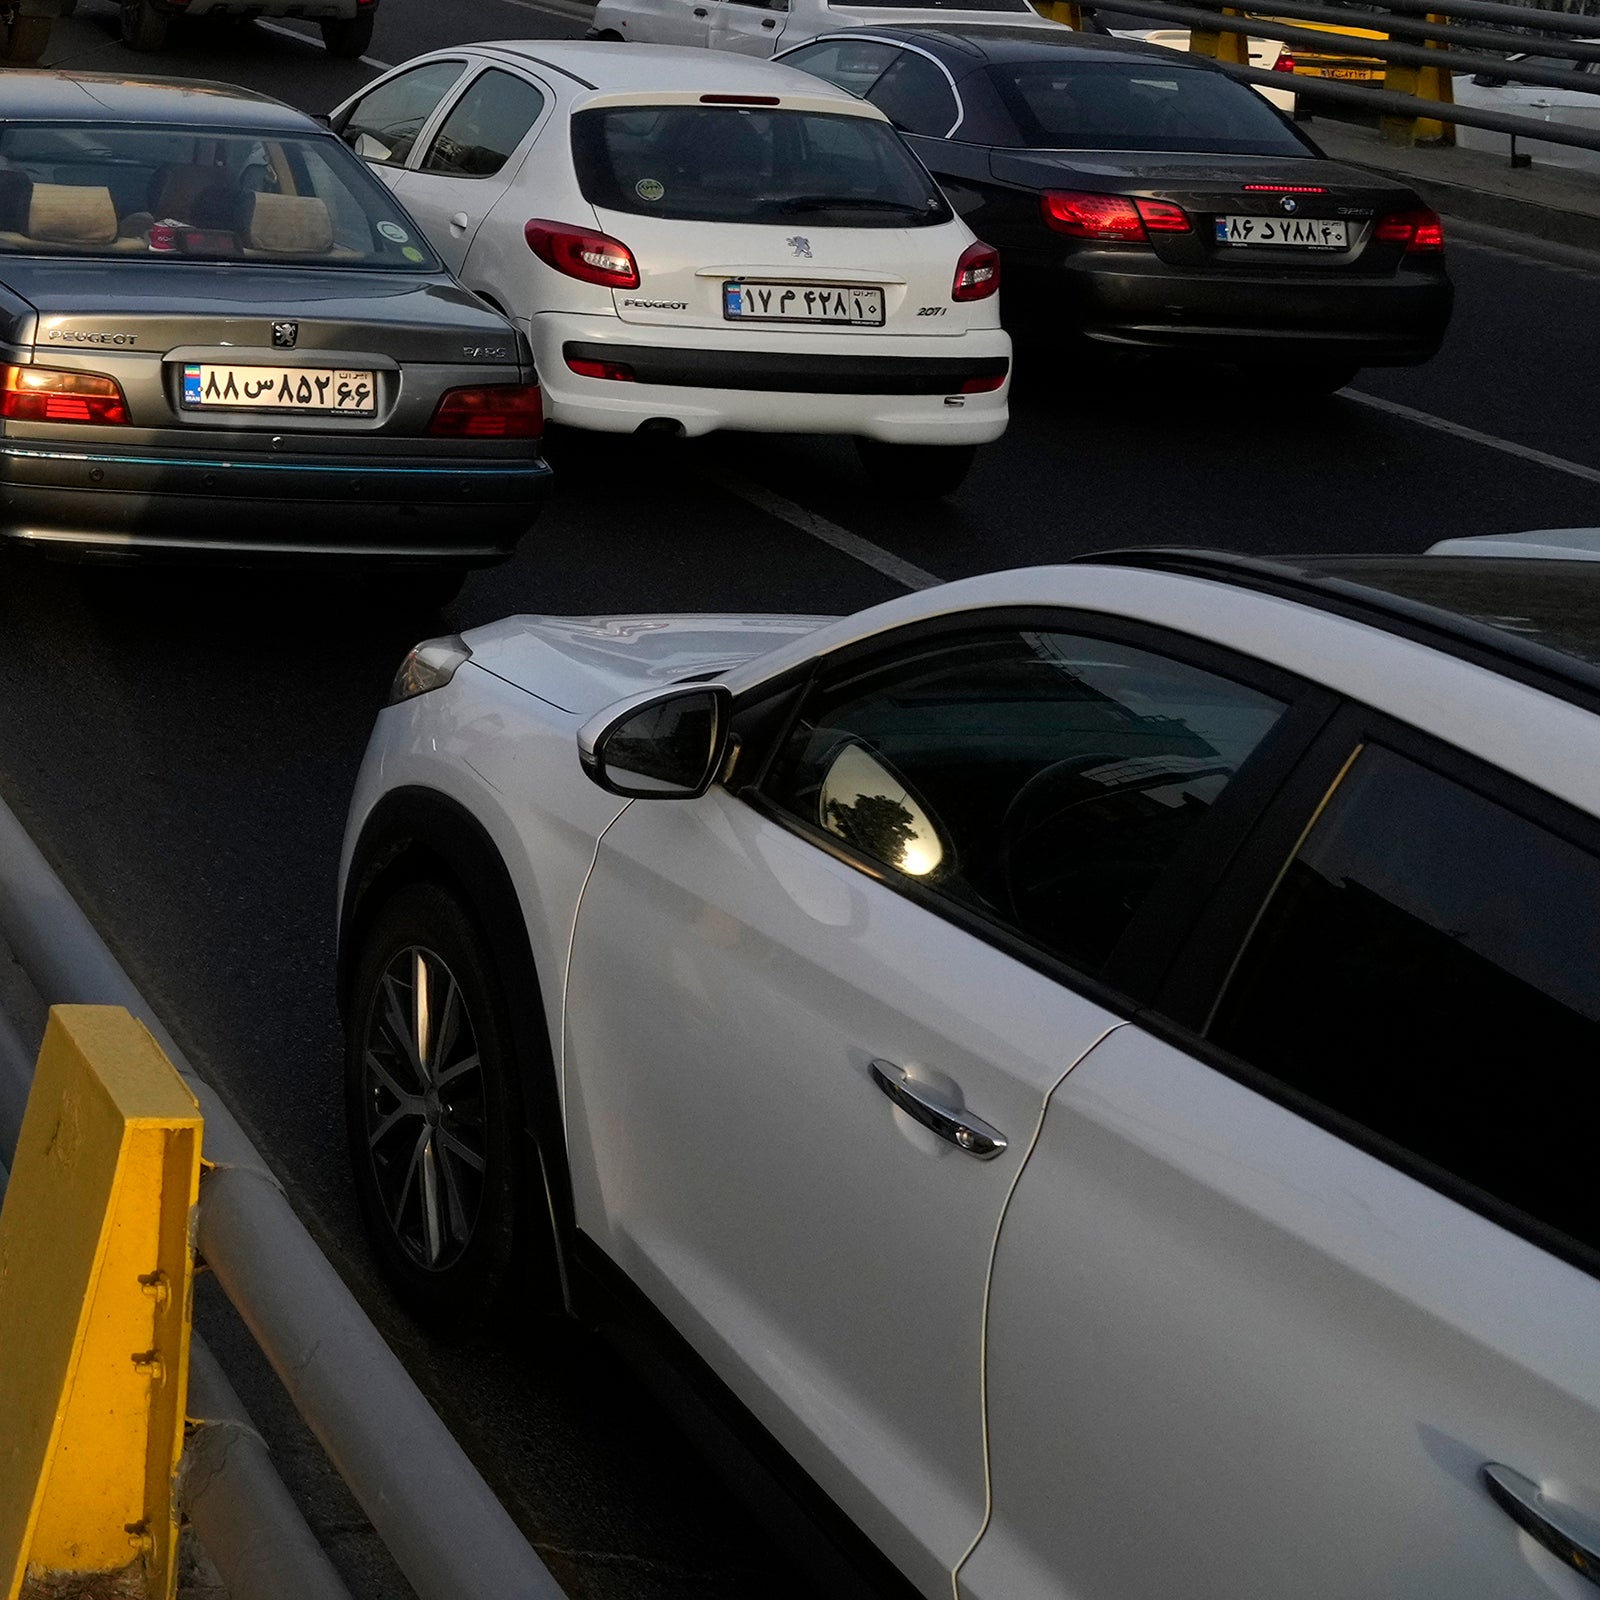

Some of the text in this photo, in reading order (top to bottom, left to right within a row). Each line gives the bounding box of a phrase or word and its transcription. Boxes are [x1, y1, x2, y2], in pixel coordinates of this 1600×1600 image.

[624, 299, 689, 311] PEUGEOT
[854, 297, 877, 319] ۱۰
[48, 330, 139, 345] PEUGEOT
[462, 346, 507, 359] PARS
[336, 381, 372, 409] ۶۶
